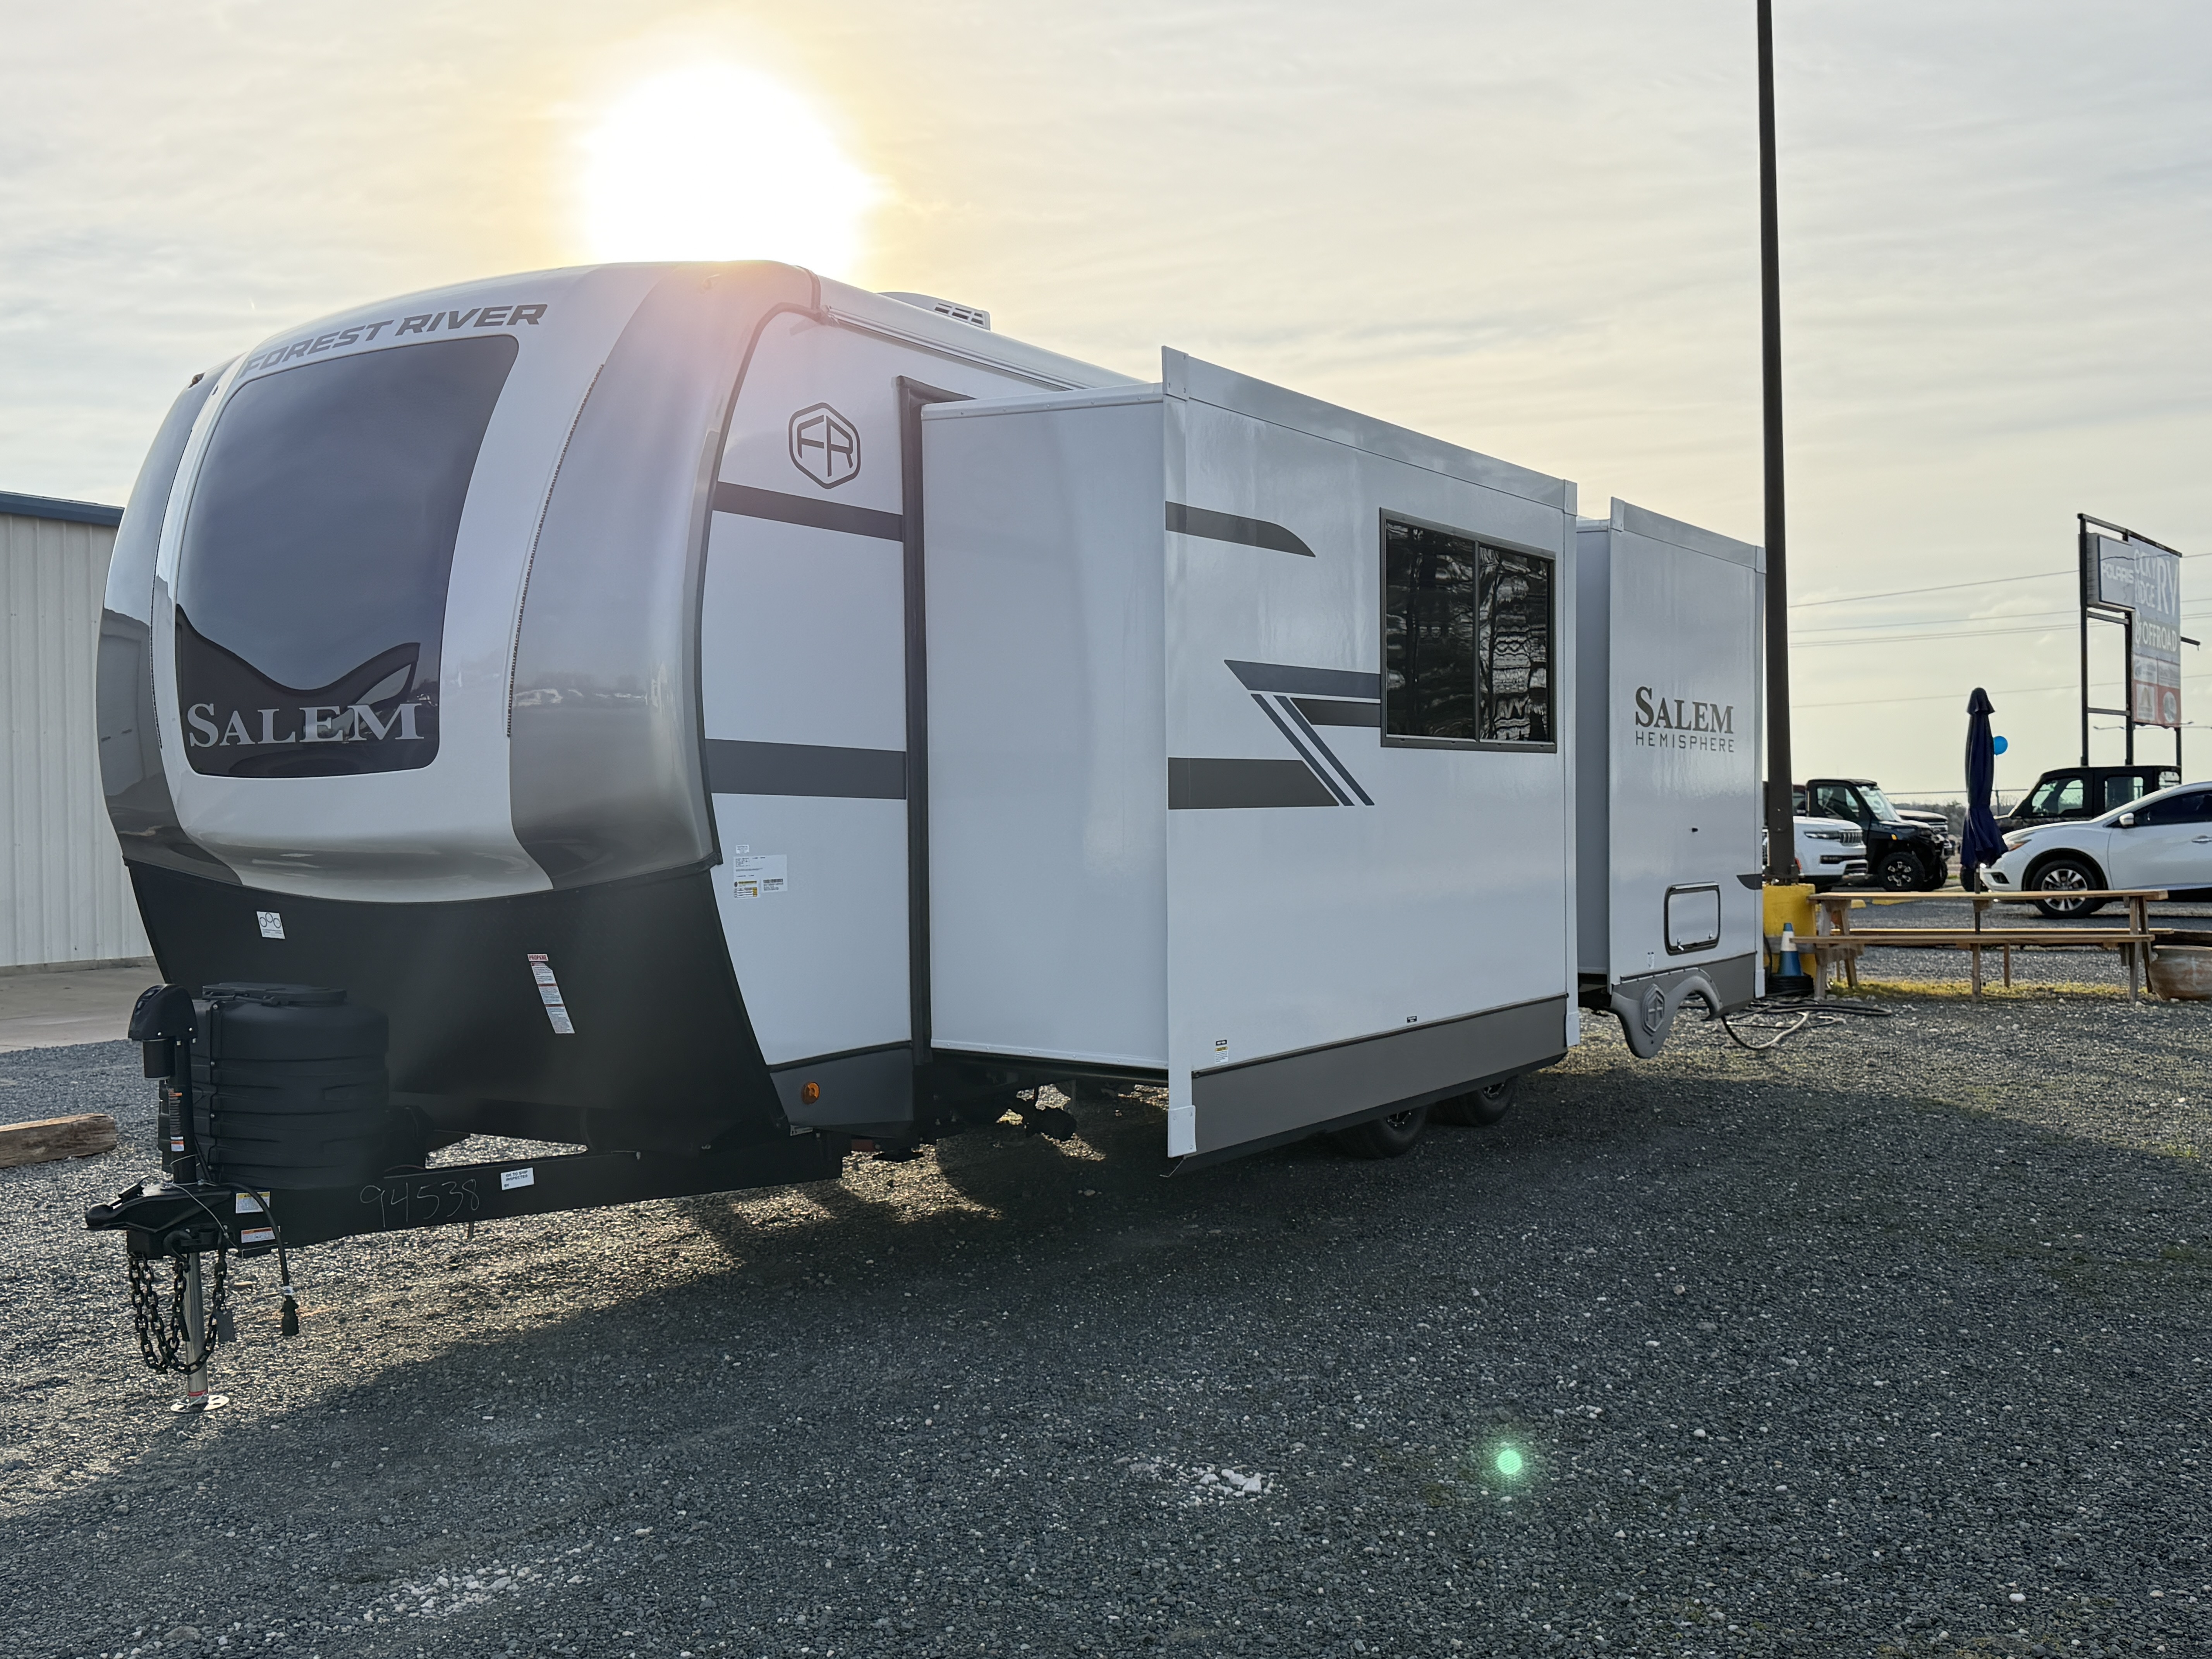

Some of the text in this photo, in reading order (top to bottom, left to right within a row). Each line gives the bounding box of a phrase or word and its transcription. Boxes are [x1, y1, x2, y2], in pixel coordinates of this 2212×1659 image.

[239, 304, 548, 379] FOREST RIVER
[2100, 562, 2134, 584] POLARIS
[2134, 549, 2156, 579] OCKY
[2135, 579, 2155, 608] IDGE
[2157, 557, 2178, 617] RV
[2142, 621, 2177, 652] OFFROAD
[187, 703, 424, 747] SALEM
[1635, 686, 1733, 734] SALEM
[1636, 731, 1735, 753] HEMISPHERE
[360, 1179, 480, 1228] 94538
